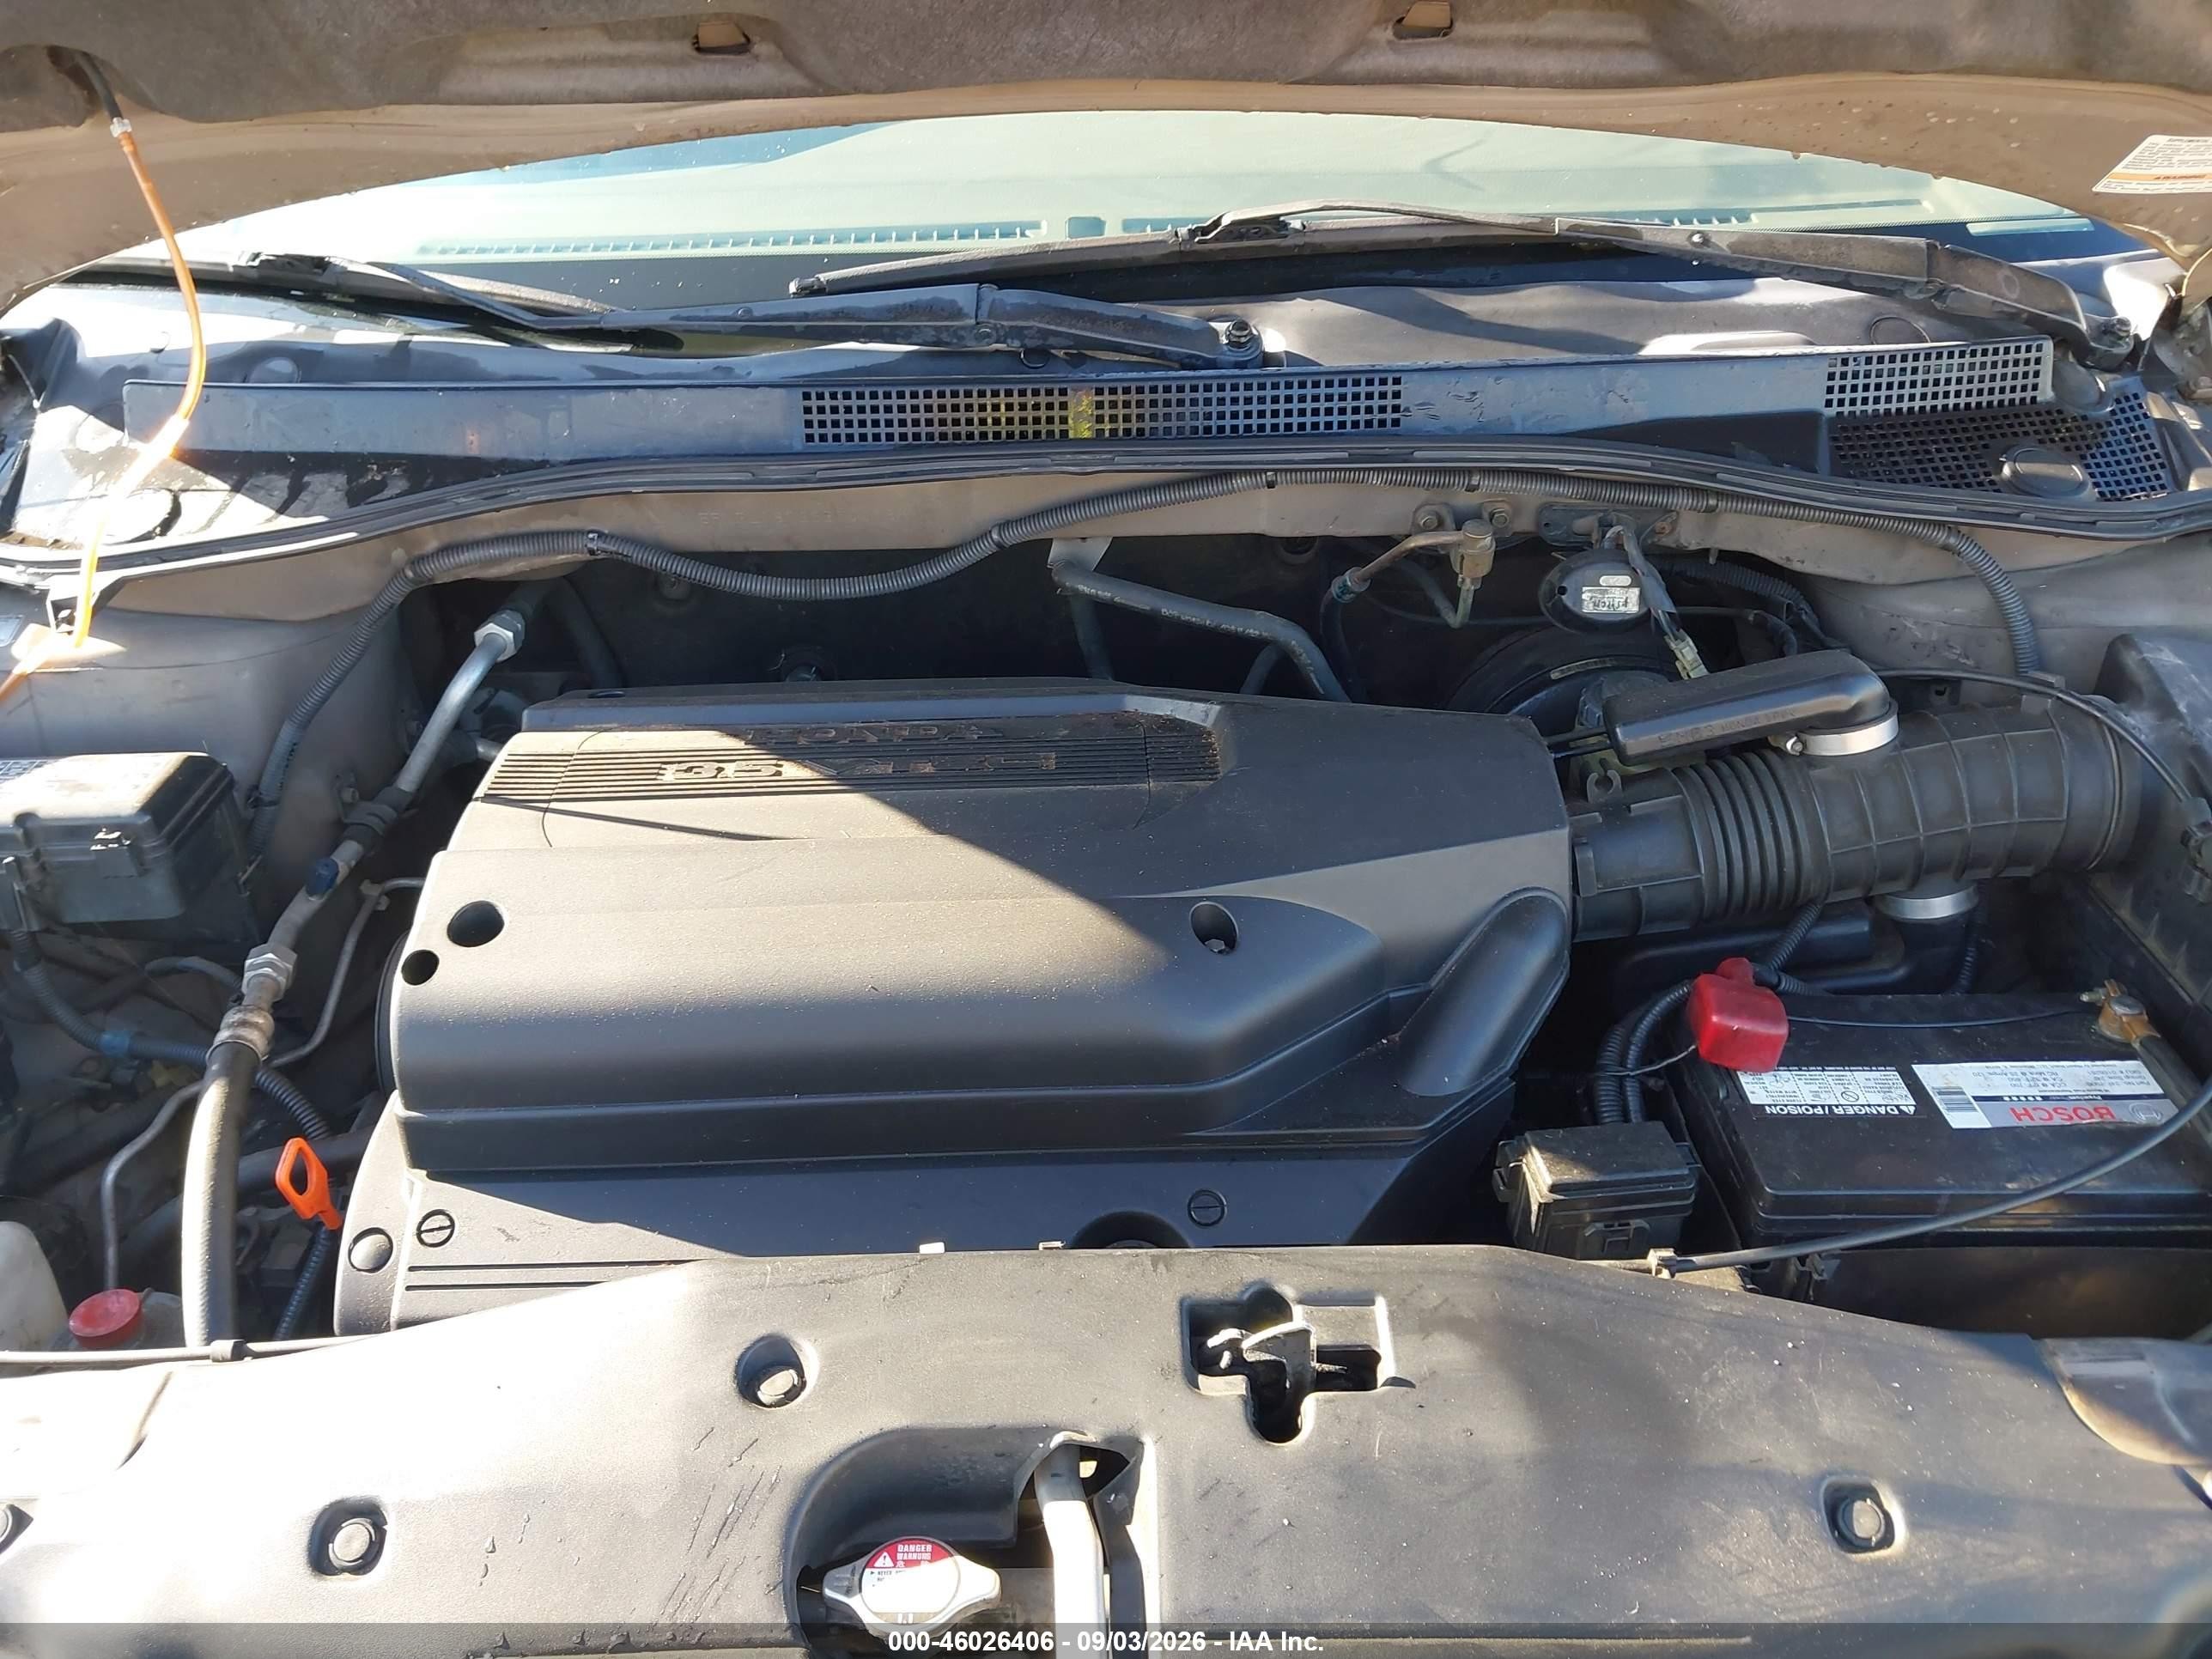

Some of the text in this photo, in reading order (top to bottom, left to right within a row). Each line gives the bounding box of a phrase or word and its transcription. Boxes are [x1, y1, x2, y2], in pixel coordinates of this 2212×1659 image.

[741, 723, 1003, 745] HONDA
[1832, 1104, 1899, 1115] DANGER
[2008, 1105, 2117, 1123] BOSCH
[896, 1544, 933, 1553] DANGER
